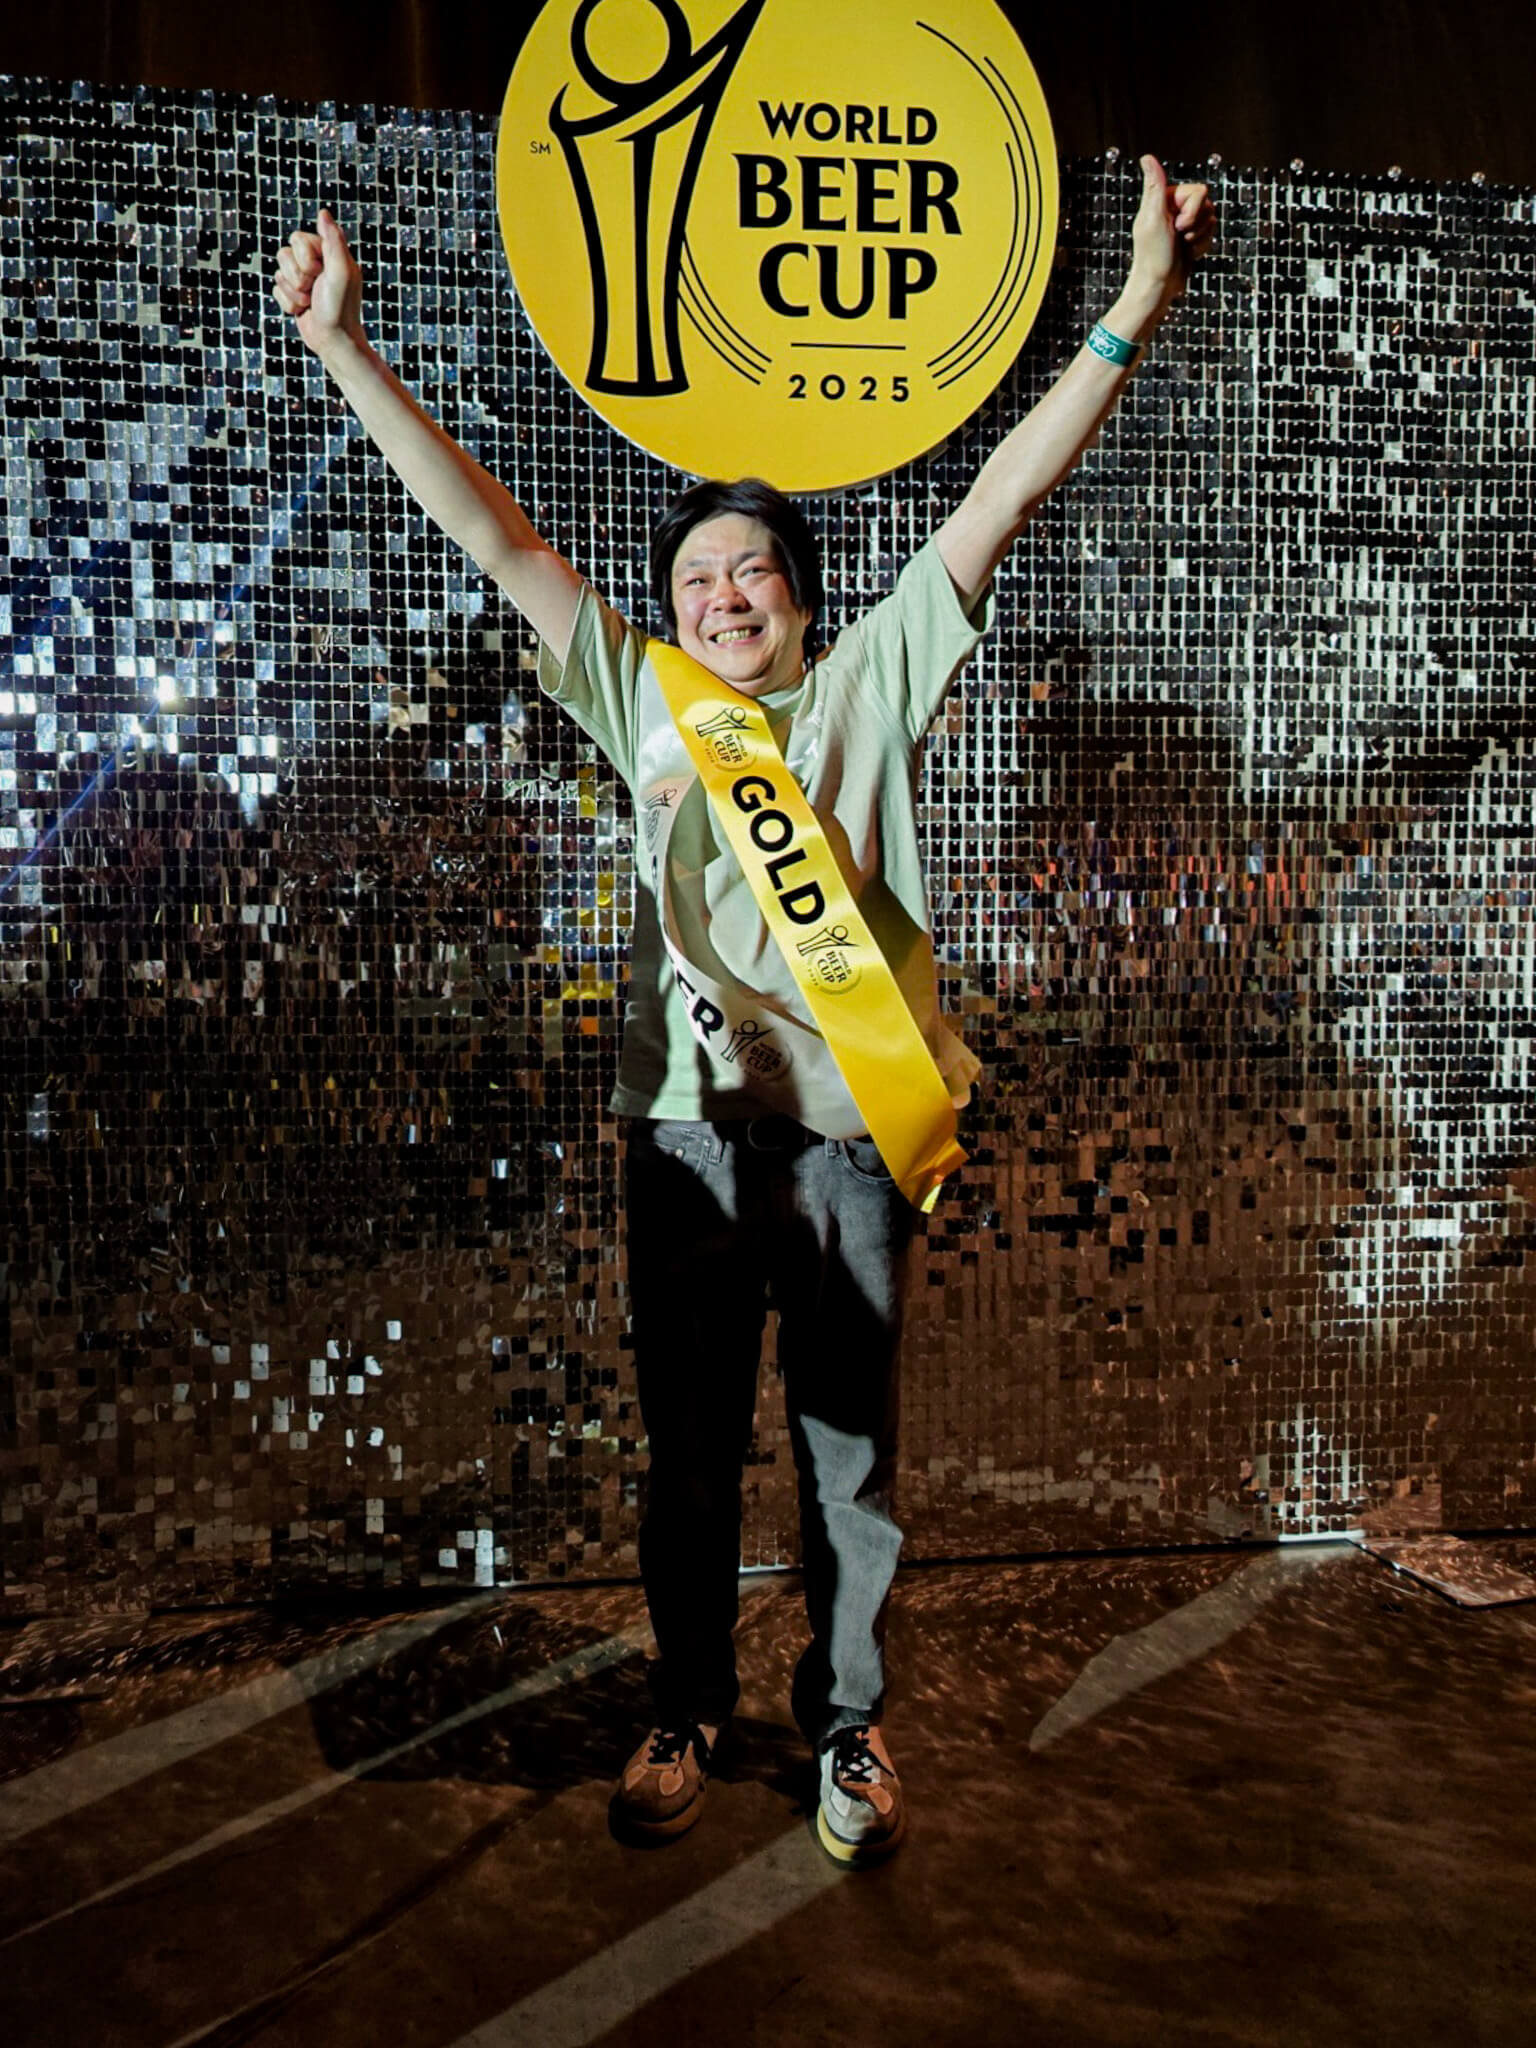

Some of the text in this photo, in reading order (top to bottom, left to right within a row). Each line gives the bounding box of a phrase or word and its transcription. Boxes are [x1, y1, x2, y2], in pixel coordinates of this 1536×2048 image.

[758, 100, 938, 145] WORLD
[530, 140, 551, 155] SM
[732, 152, 963, 235] BEER
[758, 242, 938, 320] CUP
[788, 374, 910, 403] 2025
[714, 740, 731, 763] CUP
[723, 733, 744, 764] BEER
[731, 776, 826, 925] GOLD
[816, 958, 836, 984] CUP
[825, 950, 848, 984] BEER
